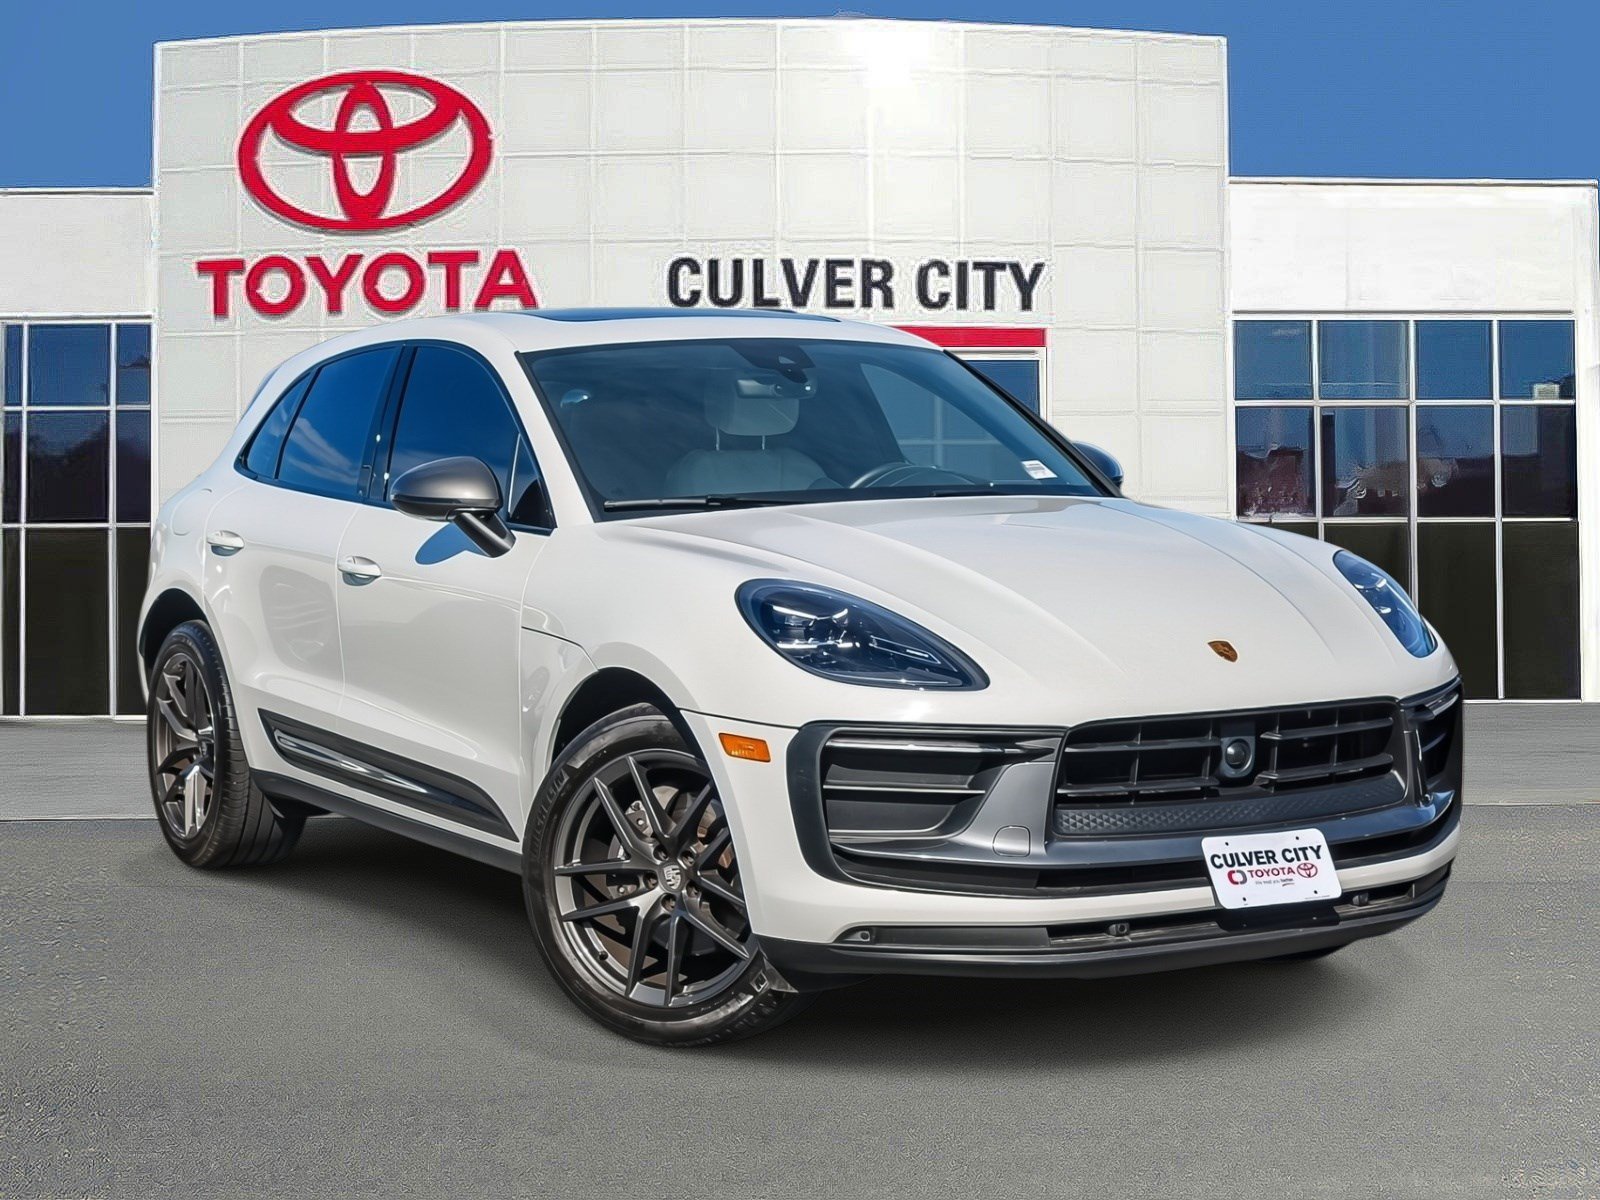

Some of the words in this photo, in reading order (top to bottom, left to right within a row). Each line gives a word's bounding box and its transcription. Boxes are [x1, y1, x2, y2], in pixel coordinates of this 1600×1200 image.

[196, 250, 539, 317] TOYOTA
[668, 257, 895, 308] CULVER
[915, 259, 1045, 311] CITY
[1210, 849, 1278, 869] CULVER
[1281, 845, 1322, 863] CITY
[1247, 866, 1296, 878] TOYOTA
